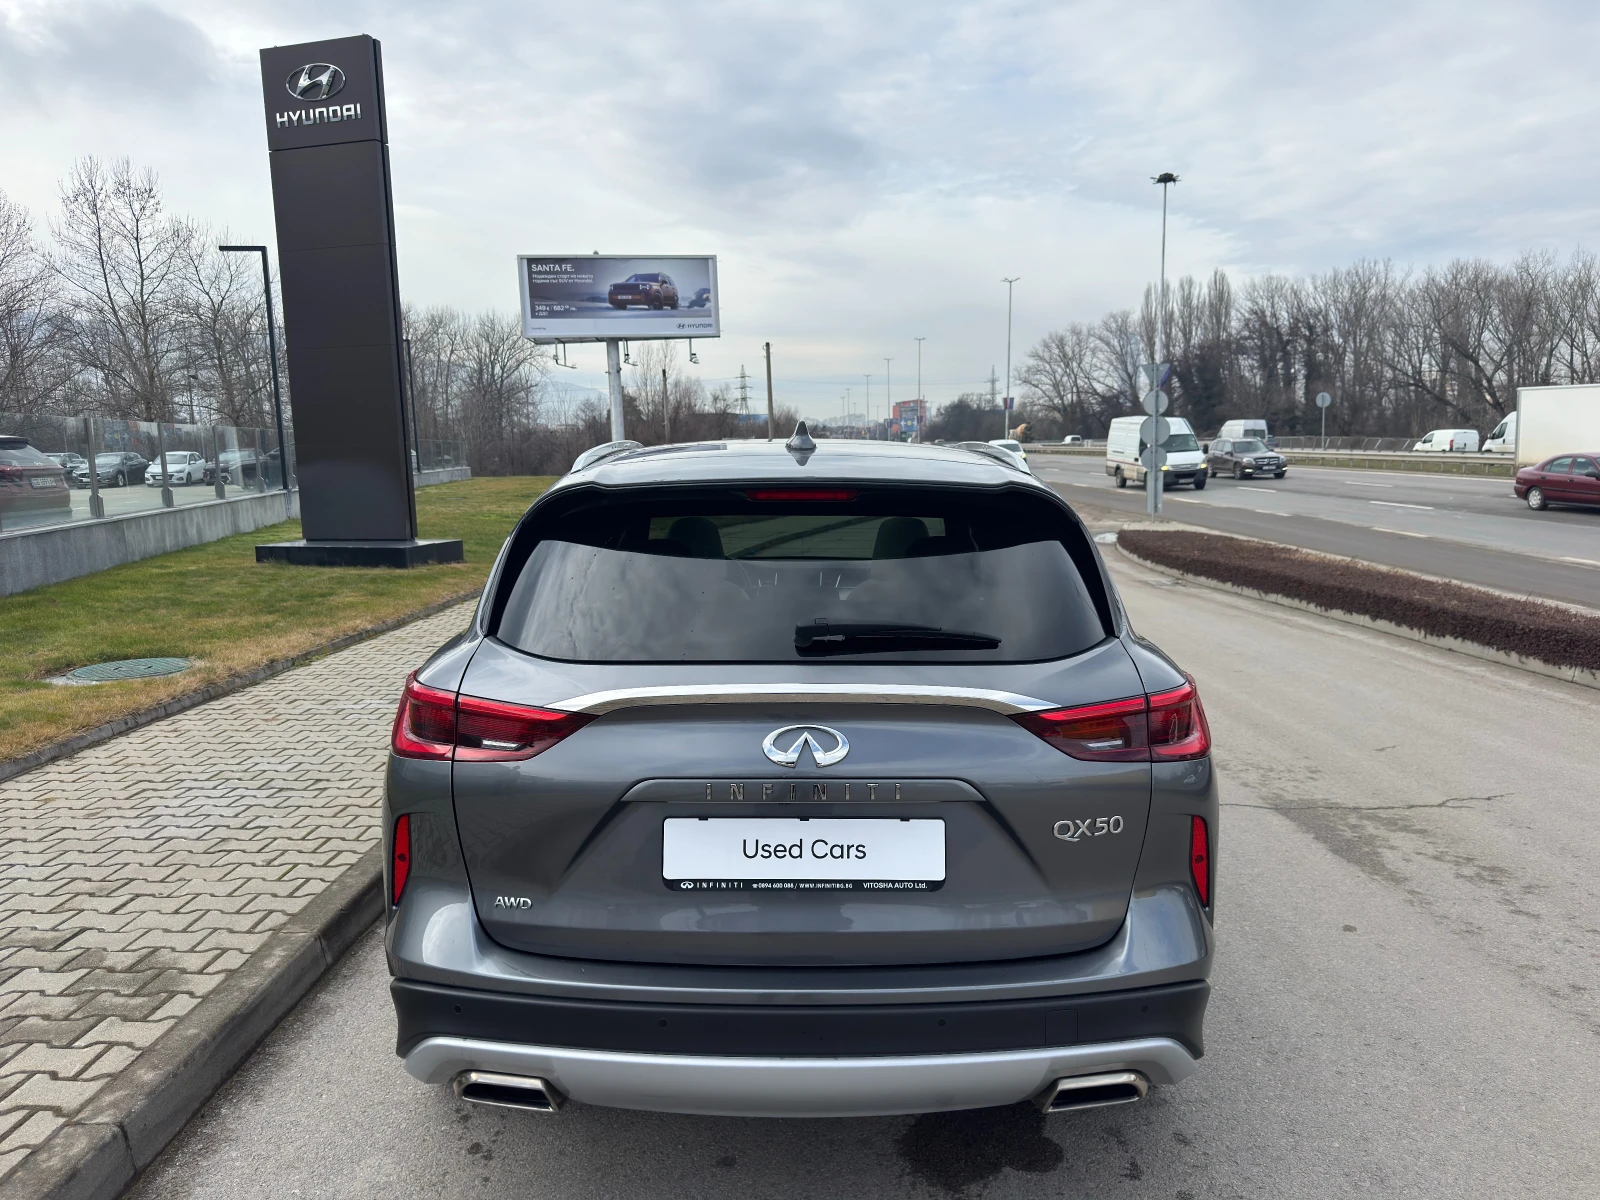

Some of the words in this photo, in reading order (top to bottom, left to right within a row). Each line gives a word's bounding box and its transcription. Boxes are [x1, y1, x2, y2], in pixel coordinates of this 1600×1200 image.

[275, 103, 362, 129] HYUNDAI
[531, 264, 561, 272] SANTA
[562, 264, 575, 272] FE.
[705, 783, 902, 800] INFINITI
[1052, 814, 1125, 843] QX50
[742, 838, 803, 860] Used
[810, 838, 867, 860] Cars
[494, 895, 533, 910] AWD
